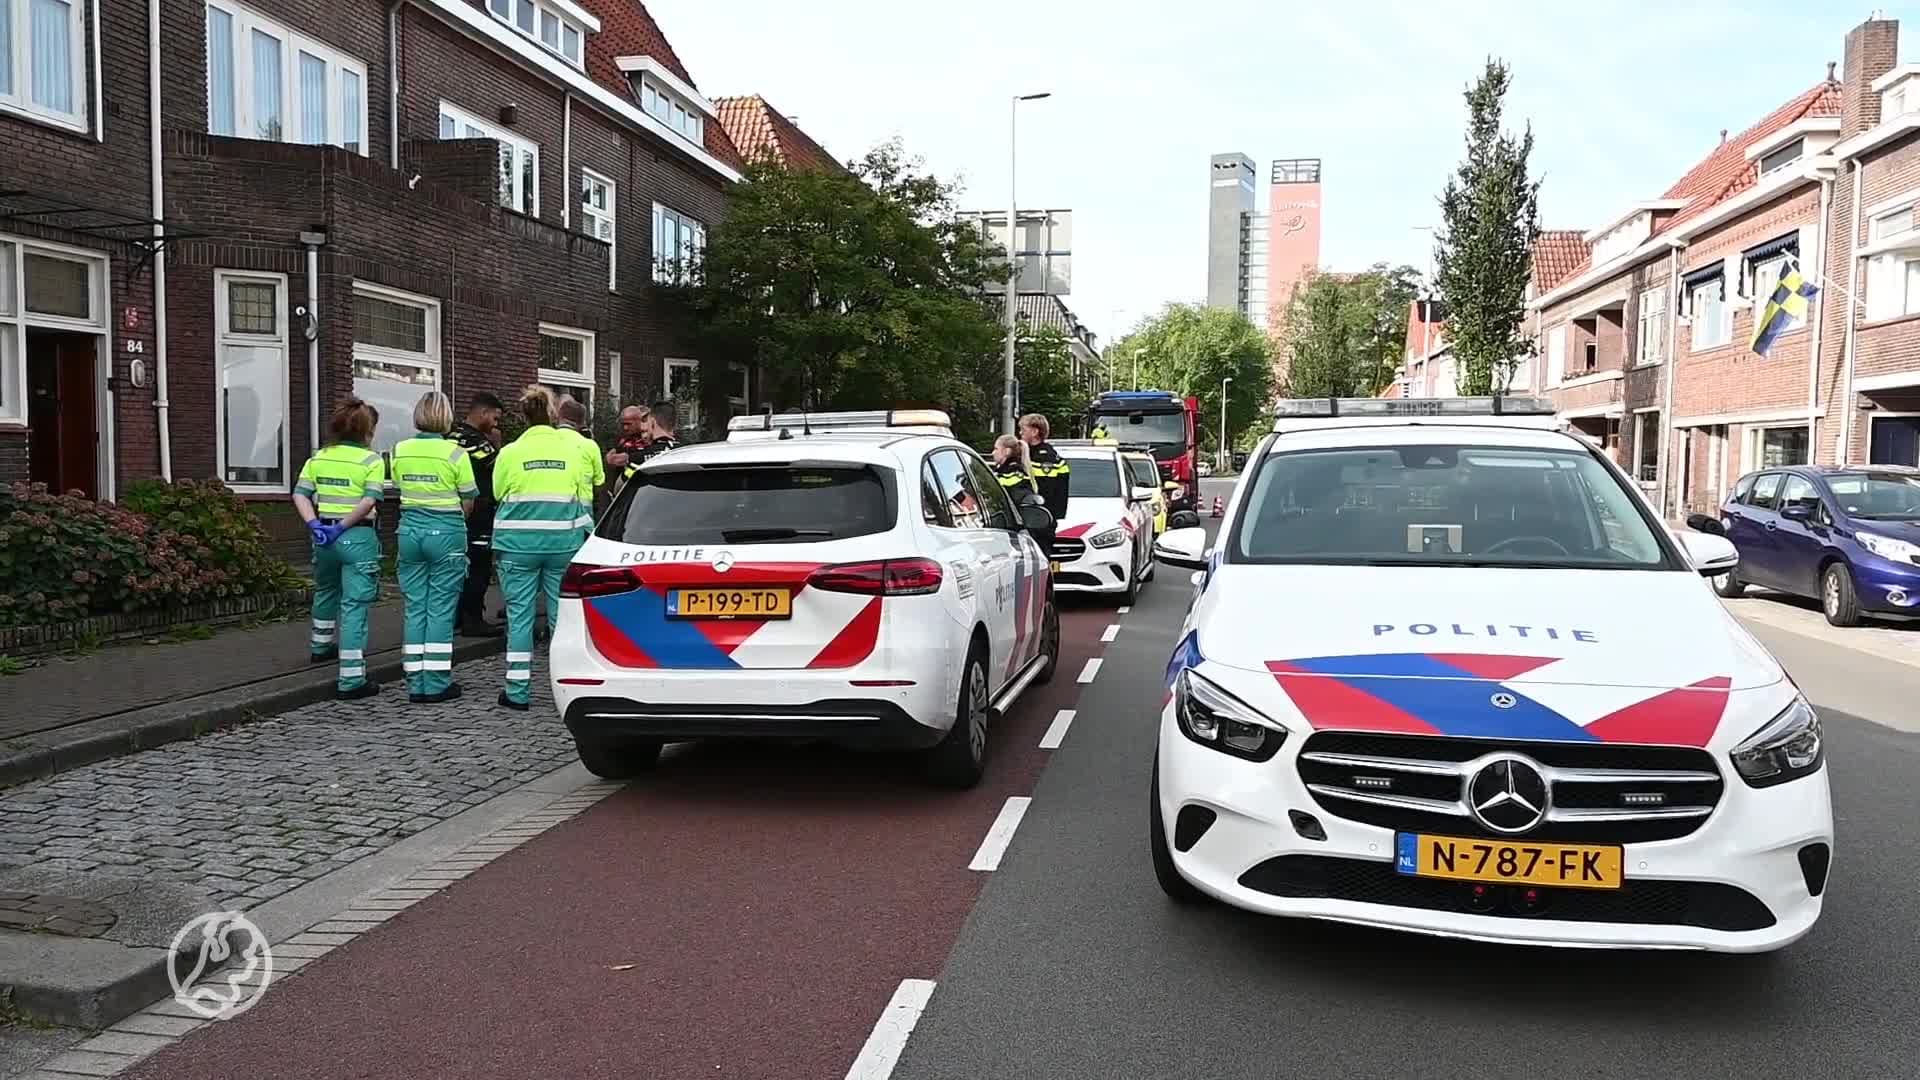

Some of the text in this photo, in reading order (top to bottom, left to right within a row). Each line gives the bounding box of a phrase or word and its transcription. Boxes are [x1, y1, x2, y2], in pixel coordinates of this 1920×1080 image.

[127, 340, 143, 352] 84
[620, 549, 704, 563] POLITIE
[688, 592, 778, 612] P-199-TD
[1373, 623, 1599, 643] POLITIE
[1399, 840, 1603, 881] NL N-787-FK
